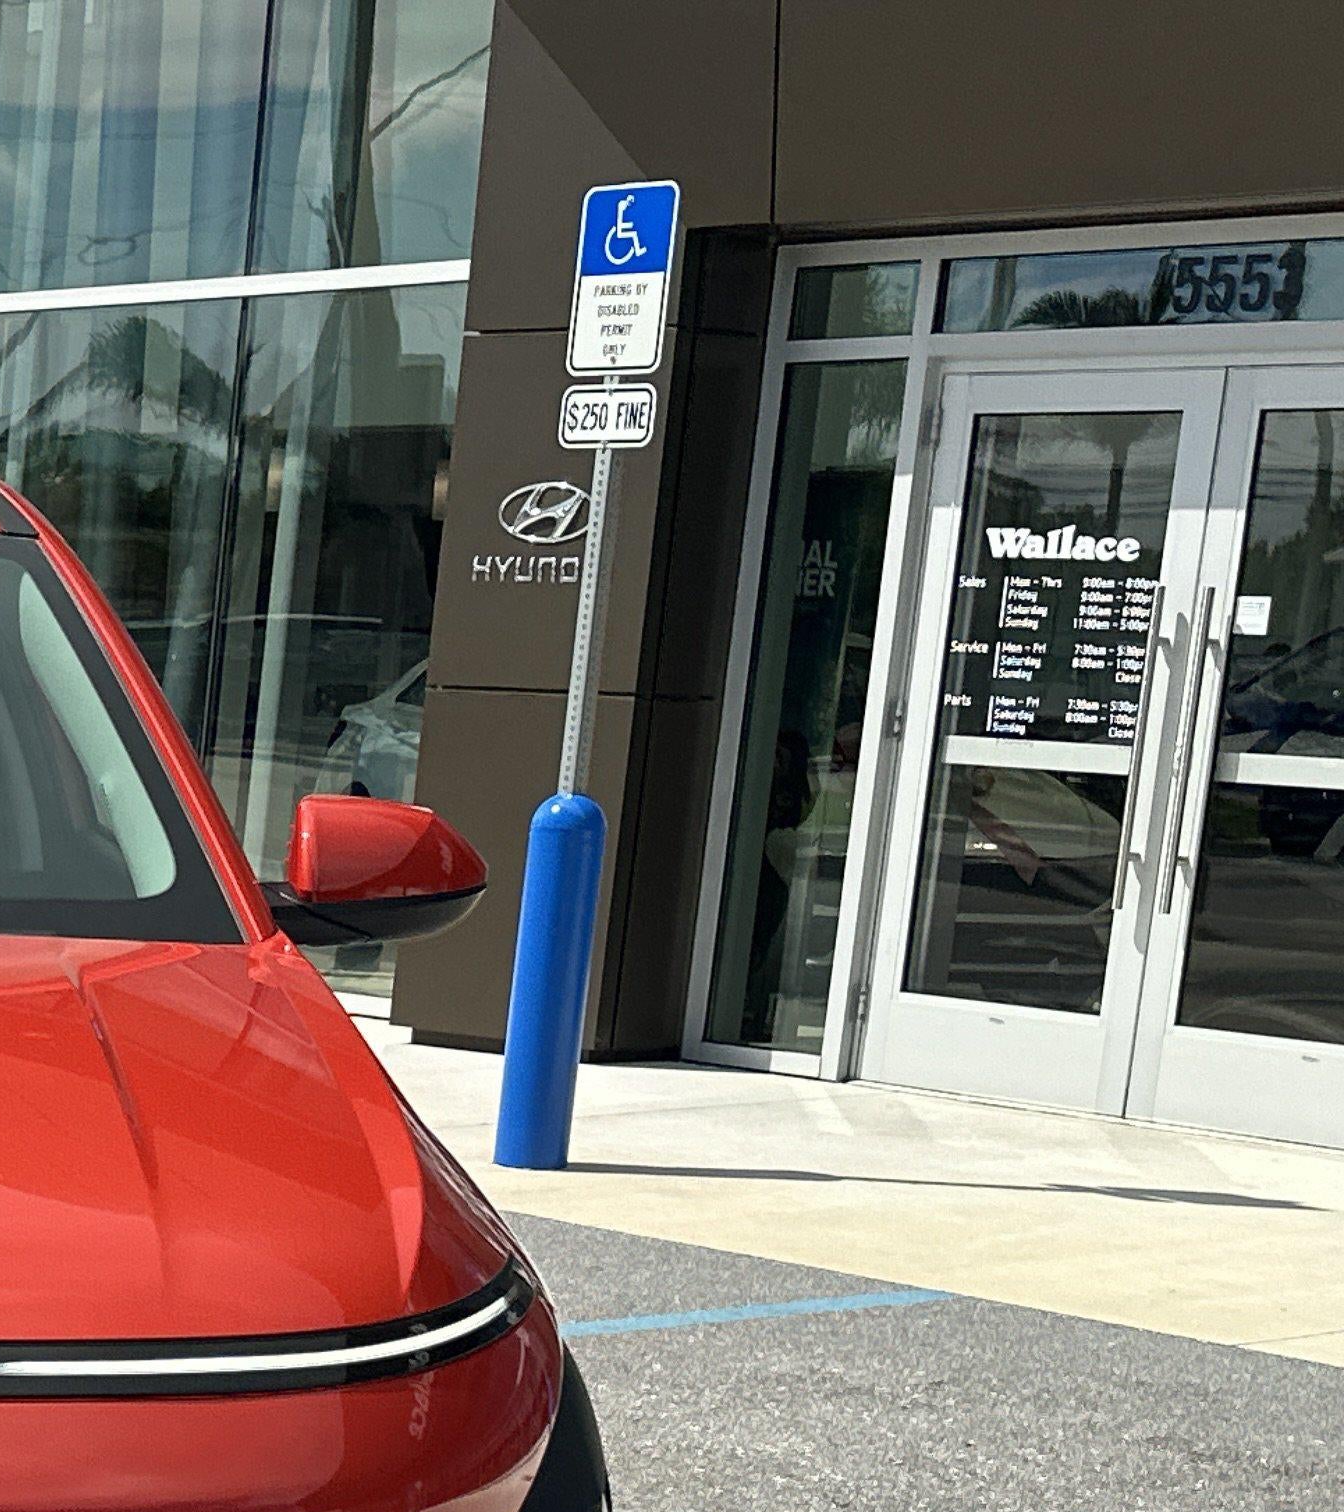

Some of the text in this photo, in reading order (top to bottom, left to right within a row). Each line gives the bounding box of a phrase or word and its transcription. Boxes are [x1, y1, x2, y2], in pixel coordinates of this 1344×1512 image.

[593, 283, 649, 297] PARKING BY
[597, 303, 640, 318] DISABLED
[600, 323, 634, 337] PERMIT
[603, 343, 627, 356] ONLY
[567, 400, 648, 433] $250 FINE
[985, 524, 1141, 562] Wallace
[471, 554, 580, 584] HYUND
[958, 575, 987, 588] Sales
[1010, 576, 1032, 588] Mon
[1082, 577, 1115, 589] 9:00am
[1008, 589, 1038, 603] Friday
[1006, 603, 1048, 618] Saturday
[1004, 616, 1039, 631] Sunday
[950, 640, 989, 654] Service
[1002, 641, 1023, 654] Mon
[1032, 642, 1047, 654] Fri
[1000, 655, 1042, 669] Saturday
[999, 668, 1033, 682] Sunday
[944, 693, 972, 707] Parts
[995, 695, 1017, 707] Mon
[1025, 696, 1040, 709] Fri
[993, 708, 1035, 724] Saturday
[992, 721, 1026, 736] Sunday
